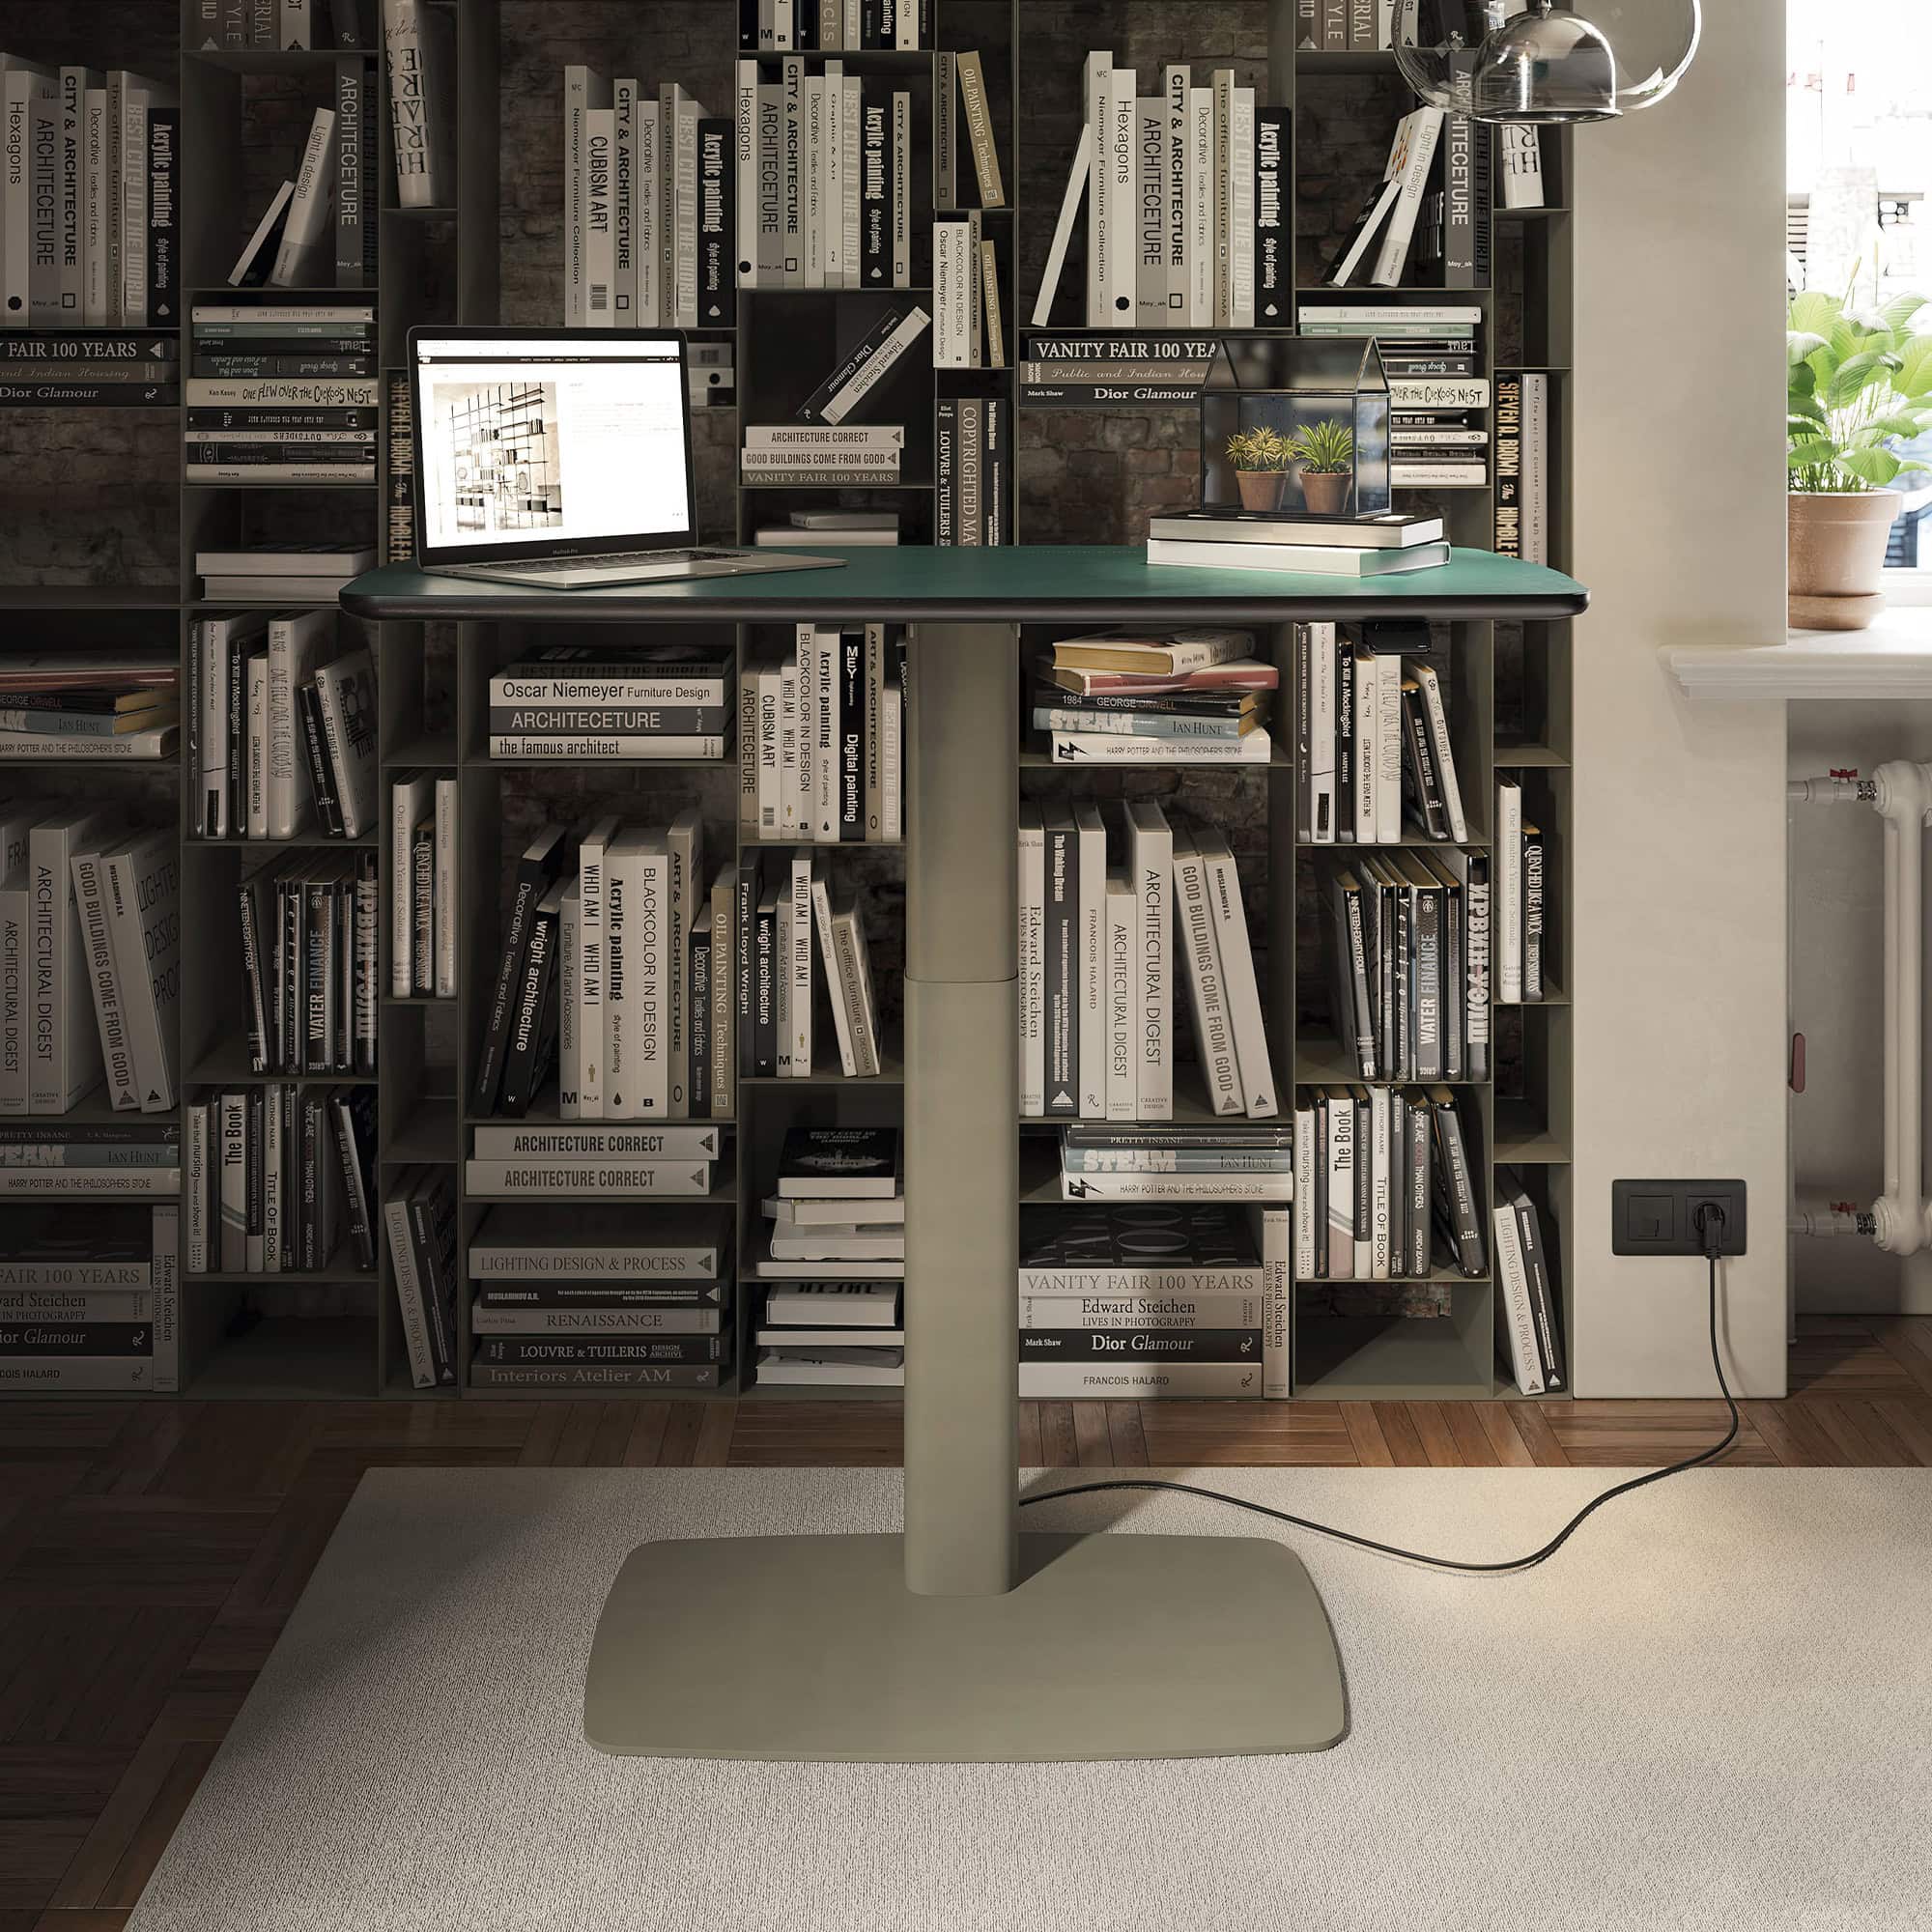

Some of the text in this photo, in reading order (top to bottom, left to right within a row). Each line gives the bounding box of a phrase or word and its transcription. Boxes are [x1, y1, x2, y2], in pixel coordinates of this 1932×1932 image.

[7, 101, 24, 185] Hexagons
[965, 69, 991, 186] OIL PAINTING Techniques
[1115, 101, 1131, 185] Hexagons
[1420, 126, 1435, 150] Light
[787, 65, 798, 234] CITY & ARCHITECTURE
[65, 75, 76, 266] CITY & ARCHITECTURE
[590, 136, 608, 233] CUBISM ART
[1172, 74, 1183, 266] CITY & ARCHITECTURE
[1259, 123, 1280, 228] Acrylic painting
[1407, 163, 1423, 199] design
[939, 230, 948, 304] Oscar Niemeyer
[9, 343, 136, 356] FAIR 100 YEARS
[1037, 343, 1215, 357] VANITY FAIR 100 YEA
[0, 387, 99, 397] Dior Glamour
[1094, 388, 1197, 399] Dior Glamour
[772, 433, 868, 442] ARCHITECTURE CORRECT
[747, 454, 885, 464] GOOD BUILDINGS COME FROM GOOD
[748, 472, 894, 482] VANITY FAIR 100 YEARS
[1496, 384, 1519, 551] STEVEN A. BROWN The HUMBLE
[1343, 657, 1350, 667] To
[503, 682, 710, 701] Oscar Niemeyer Furniture Design
[819, 651, 831, 748] Acrylic painting
[1063, 696, 1136, 708] 1984 GEORGE
[512, 711, 661, 727] ARCHITECETURE
[1341, 689, 1350, 736] Mockingbird
[500, 740, 619, 754] the famous architect
[763, 696, 775, 767] CUBISM ART
[844, 734, 858, 821] Digital painting
[584, 866, 599, 894] WHO
[584, 899, 599, 917] AM
[610, 878, 625, 1001] Acrylic painting
[740, 927, 750, 964] Lloyd
[37, 866, 54, 1061] ARCHITECTURAL DIGEST
[584, 944, 599, 972] WHO
[644, 868, 656, 1060] BLACKCOLOR IN DESIGN
[1031, 907, 1041, 1037] Edward Steichen
[1146, 870, 1160, 1065] ARCHITECTURAL DIGEST
[517, 921, 548, 1052] wright architecture
[584, 979, 599, 996] AM
[1182, 867, 1233, 1092] GOOD BUILDINGS COME FROM GOOD
[1421, 934, 1435, 1044] WATER FINANCE
[715, 913, 727, 1090] OIL PAINTING Techniques
[1113, 924, 1127, 1078] ARCHITECTURAL DIGEST
[225, 1105, 242, 1166] The Book
[514, 1137, 663, 1151] ARCHITECTURE CORRECT
[1334, 1111, 1350, 1171] The Book
[46, 1269, 139, 1283] 100 YEARS
[482, 1258, 685, 1270] LIGHTING DESIGN & PROCESS
[1028, 1275, 1253, 1290] VANITY FAIR 100 YEARS
[547, 1315, 662, 1326] RENAISSANCE
[1082, 1299, 1196, 1313] Edward Steichen
[24, 1329, 85, 1344] Glamour
[1092, 1335, 1193, 1350] Dior Glamour
[490, 1369, 671, 1382] Interiors Atelier AM
[1083, 1377, 1169, 1385] FRANCOIS HALARD
